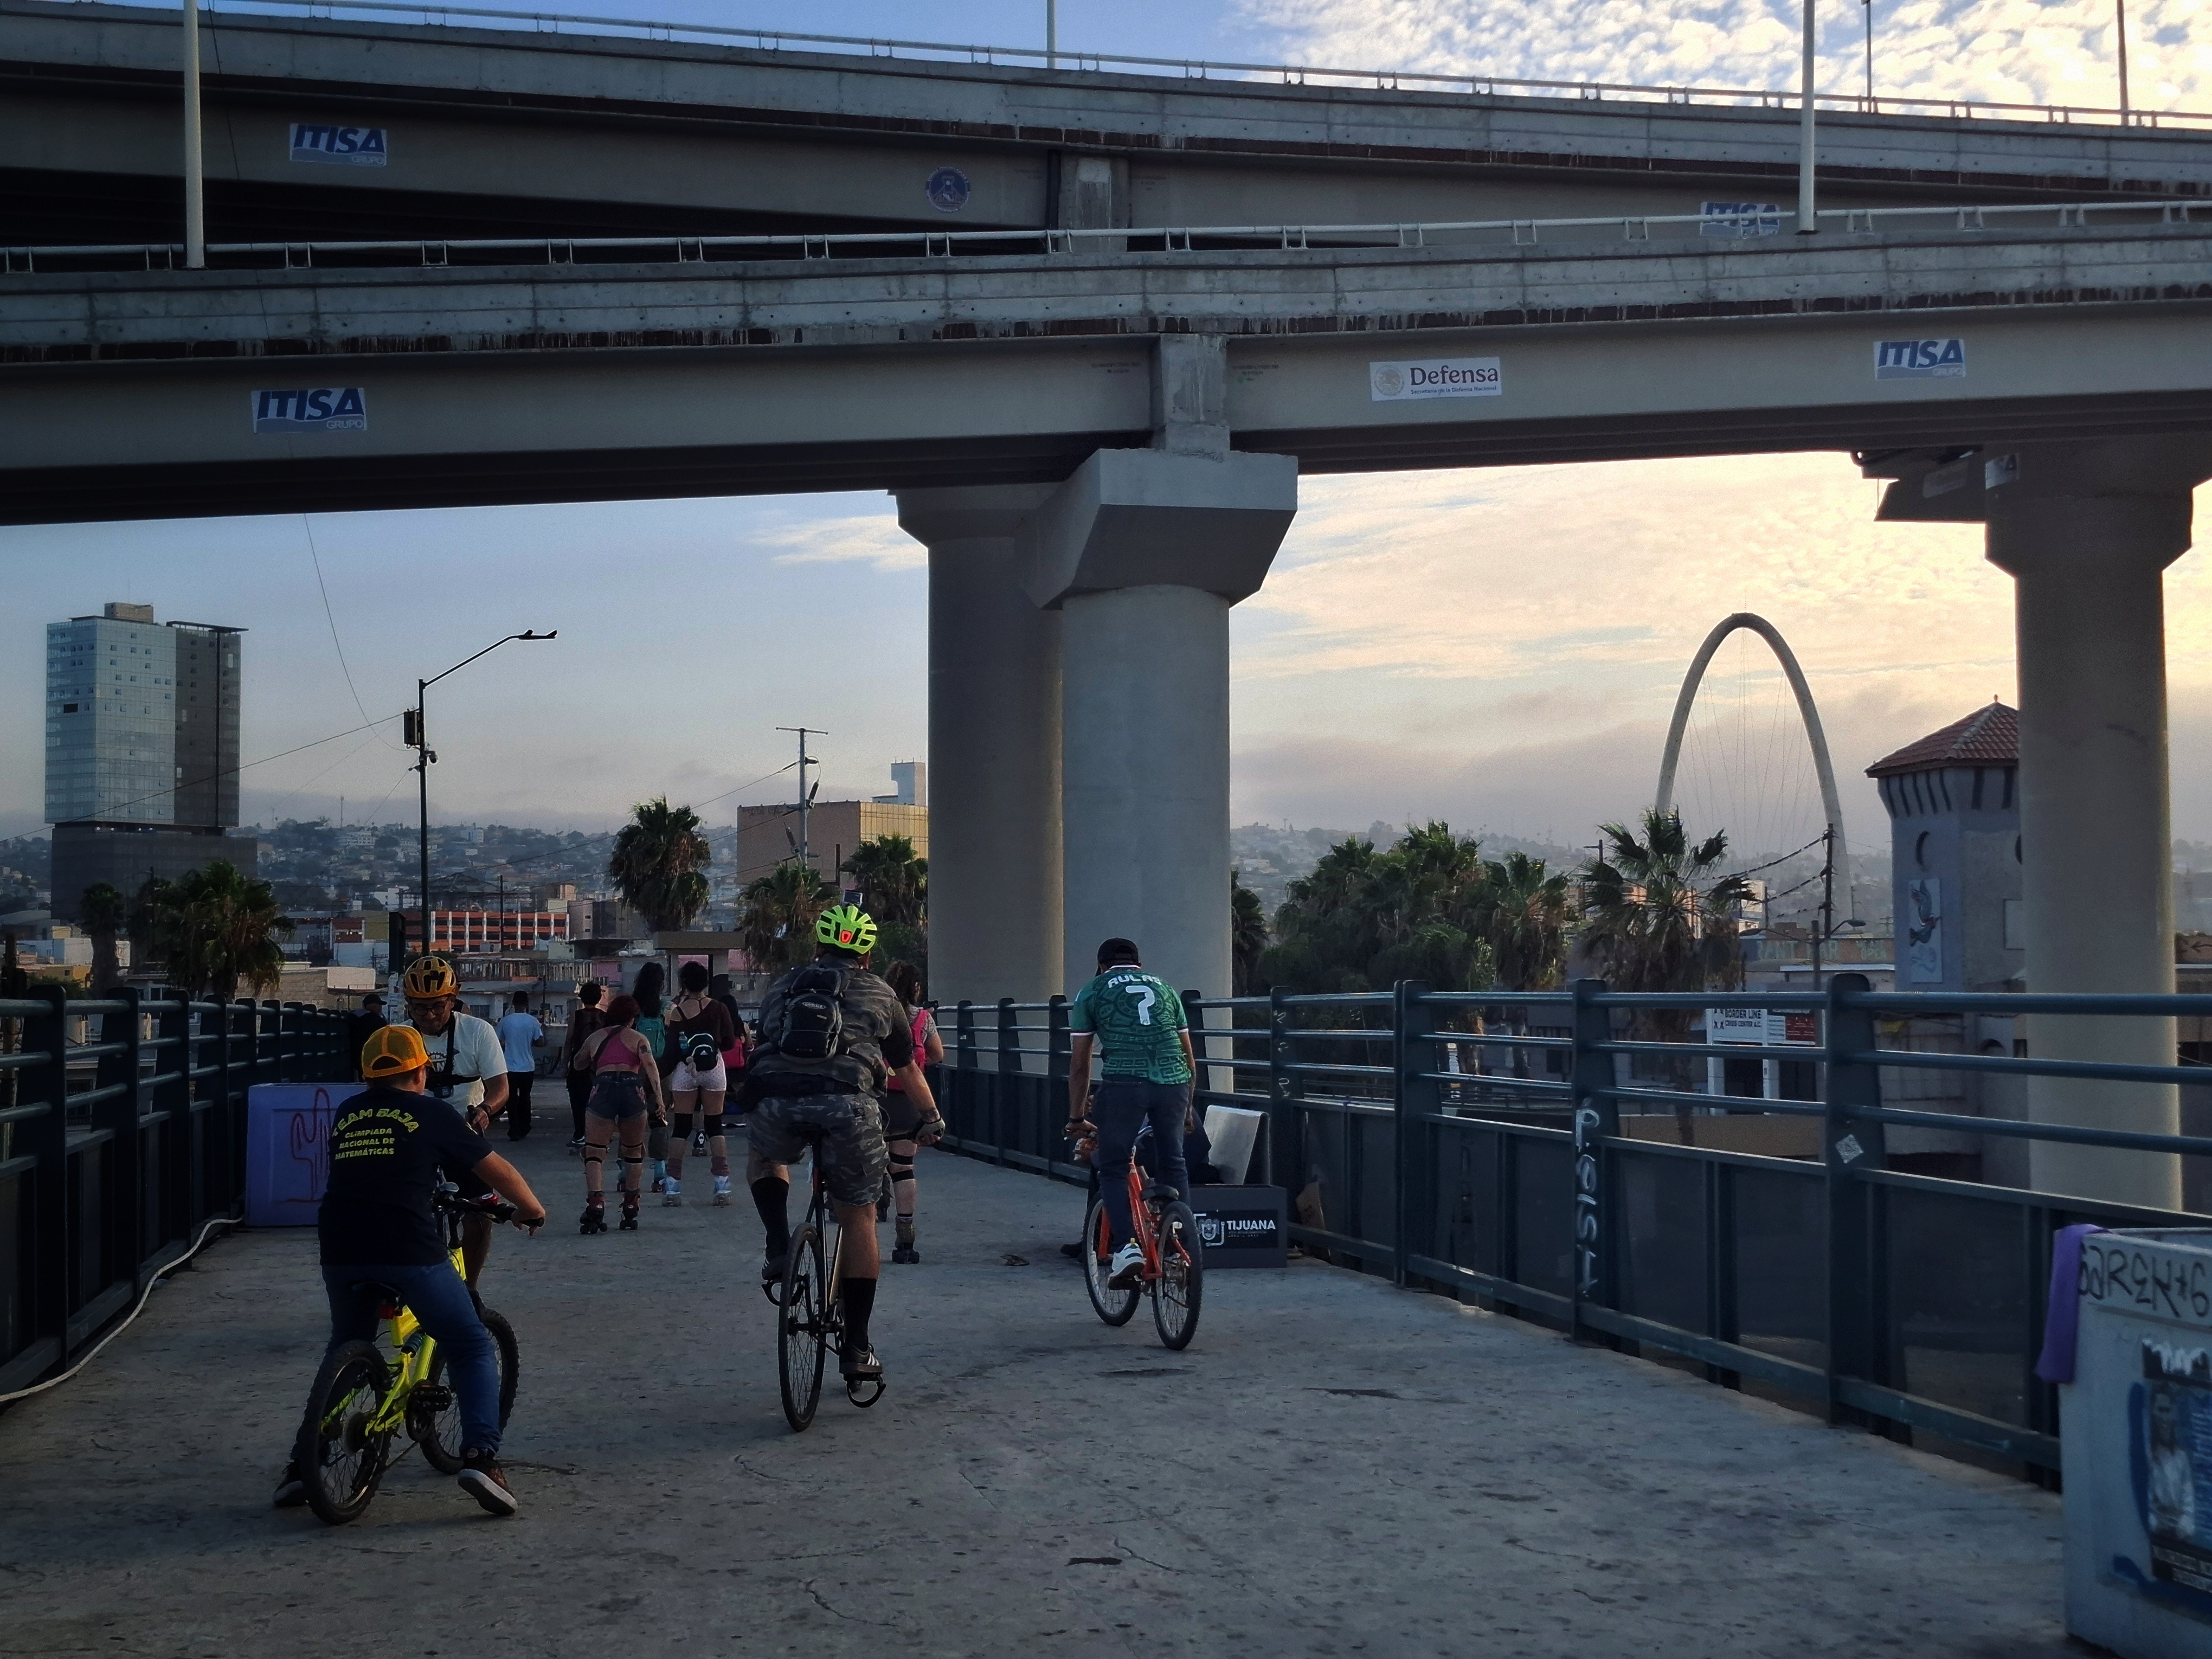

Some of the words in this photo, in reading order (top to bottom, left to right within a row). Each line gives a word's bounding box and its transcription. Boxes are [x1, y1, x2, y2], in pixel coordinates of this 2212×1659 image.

[294, 124, 385, 154] ITISA
[1878, 339, 1963, 368] ITISA
[1410, 365, 1499, 385] Defensa
[257, 388, 364, 420] ITISA
[326, 420, 363, 429] GRUPO
[1125, 985, 1155, 1025] 7
[376, 1108, 419, 1133] BAJA
[1226, 1219, 1276, 1230] TIJUANA
